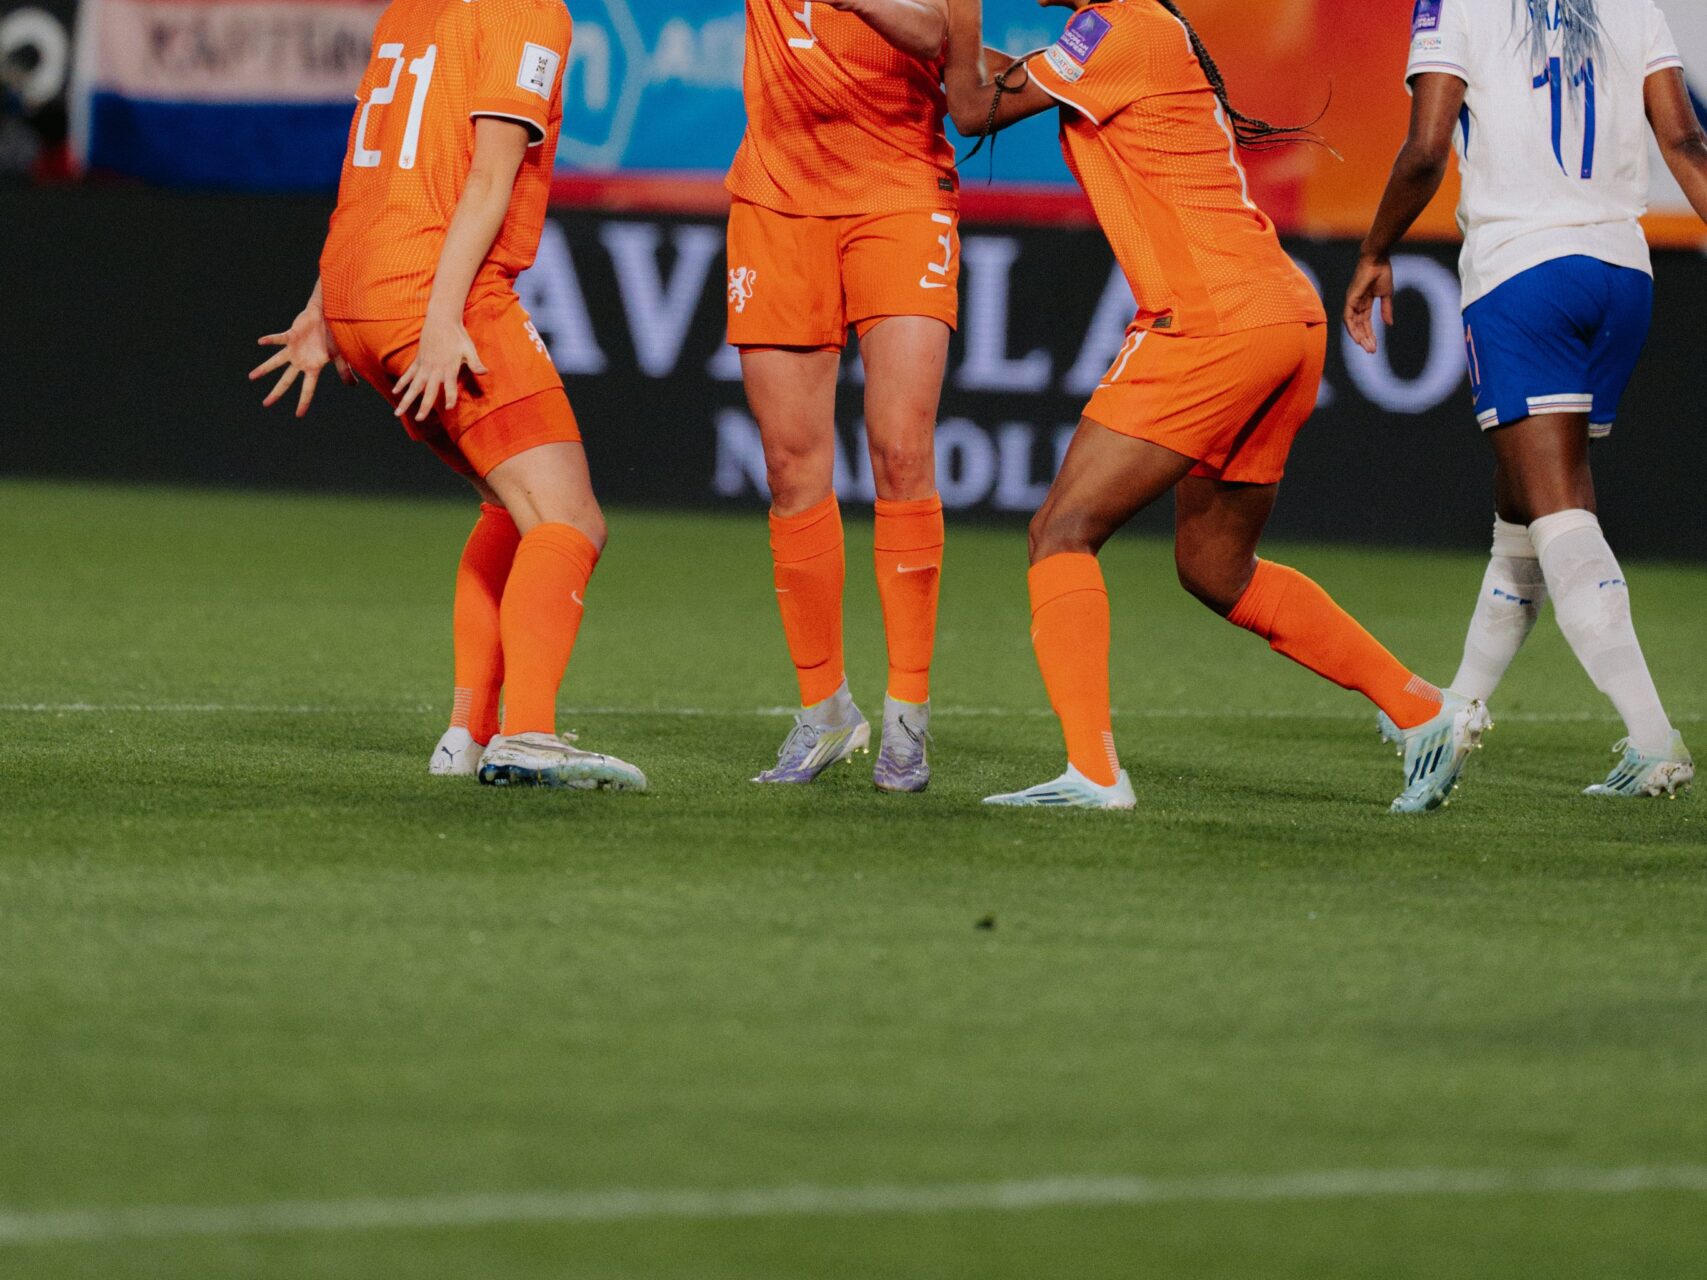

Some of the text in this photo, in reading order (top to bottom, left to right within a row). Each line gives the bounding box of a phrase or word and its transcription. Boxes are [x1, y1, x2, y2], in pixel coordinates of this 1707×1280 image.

[352, 42, 438, 170] 21
[1532, 56, 1596, 180] 11
[927, 212, 952, 276] 3
